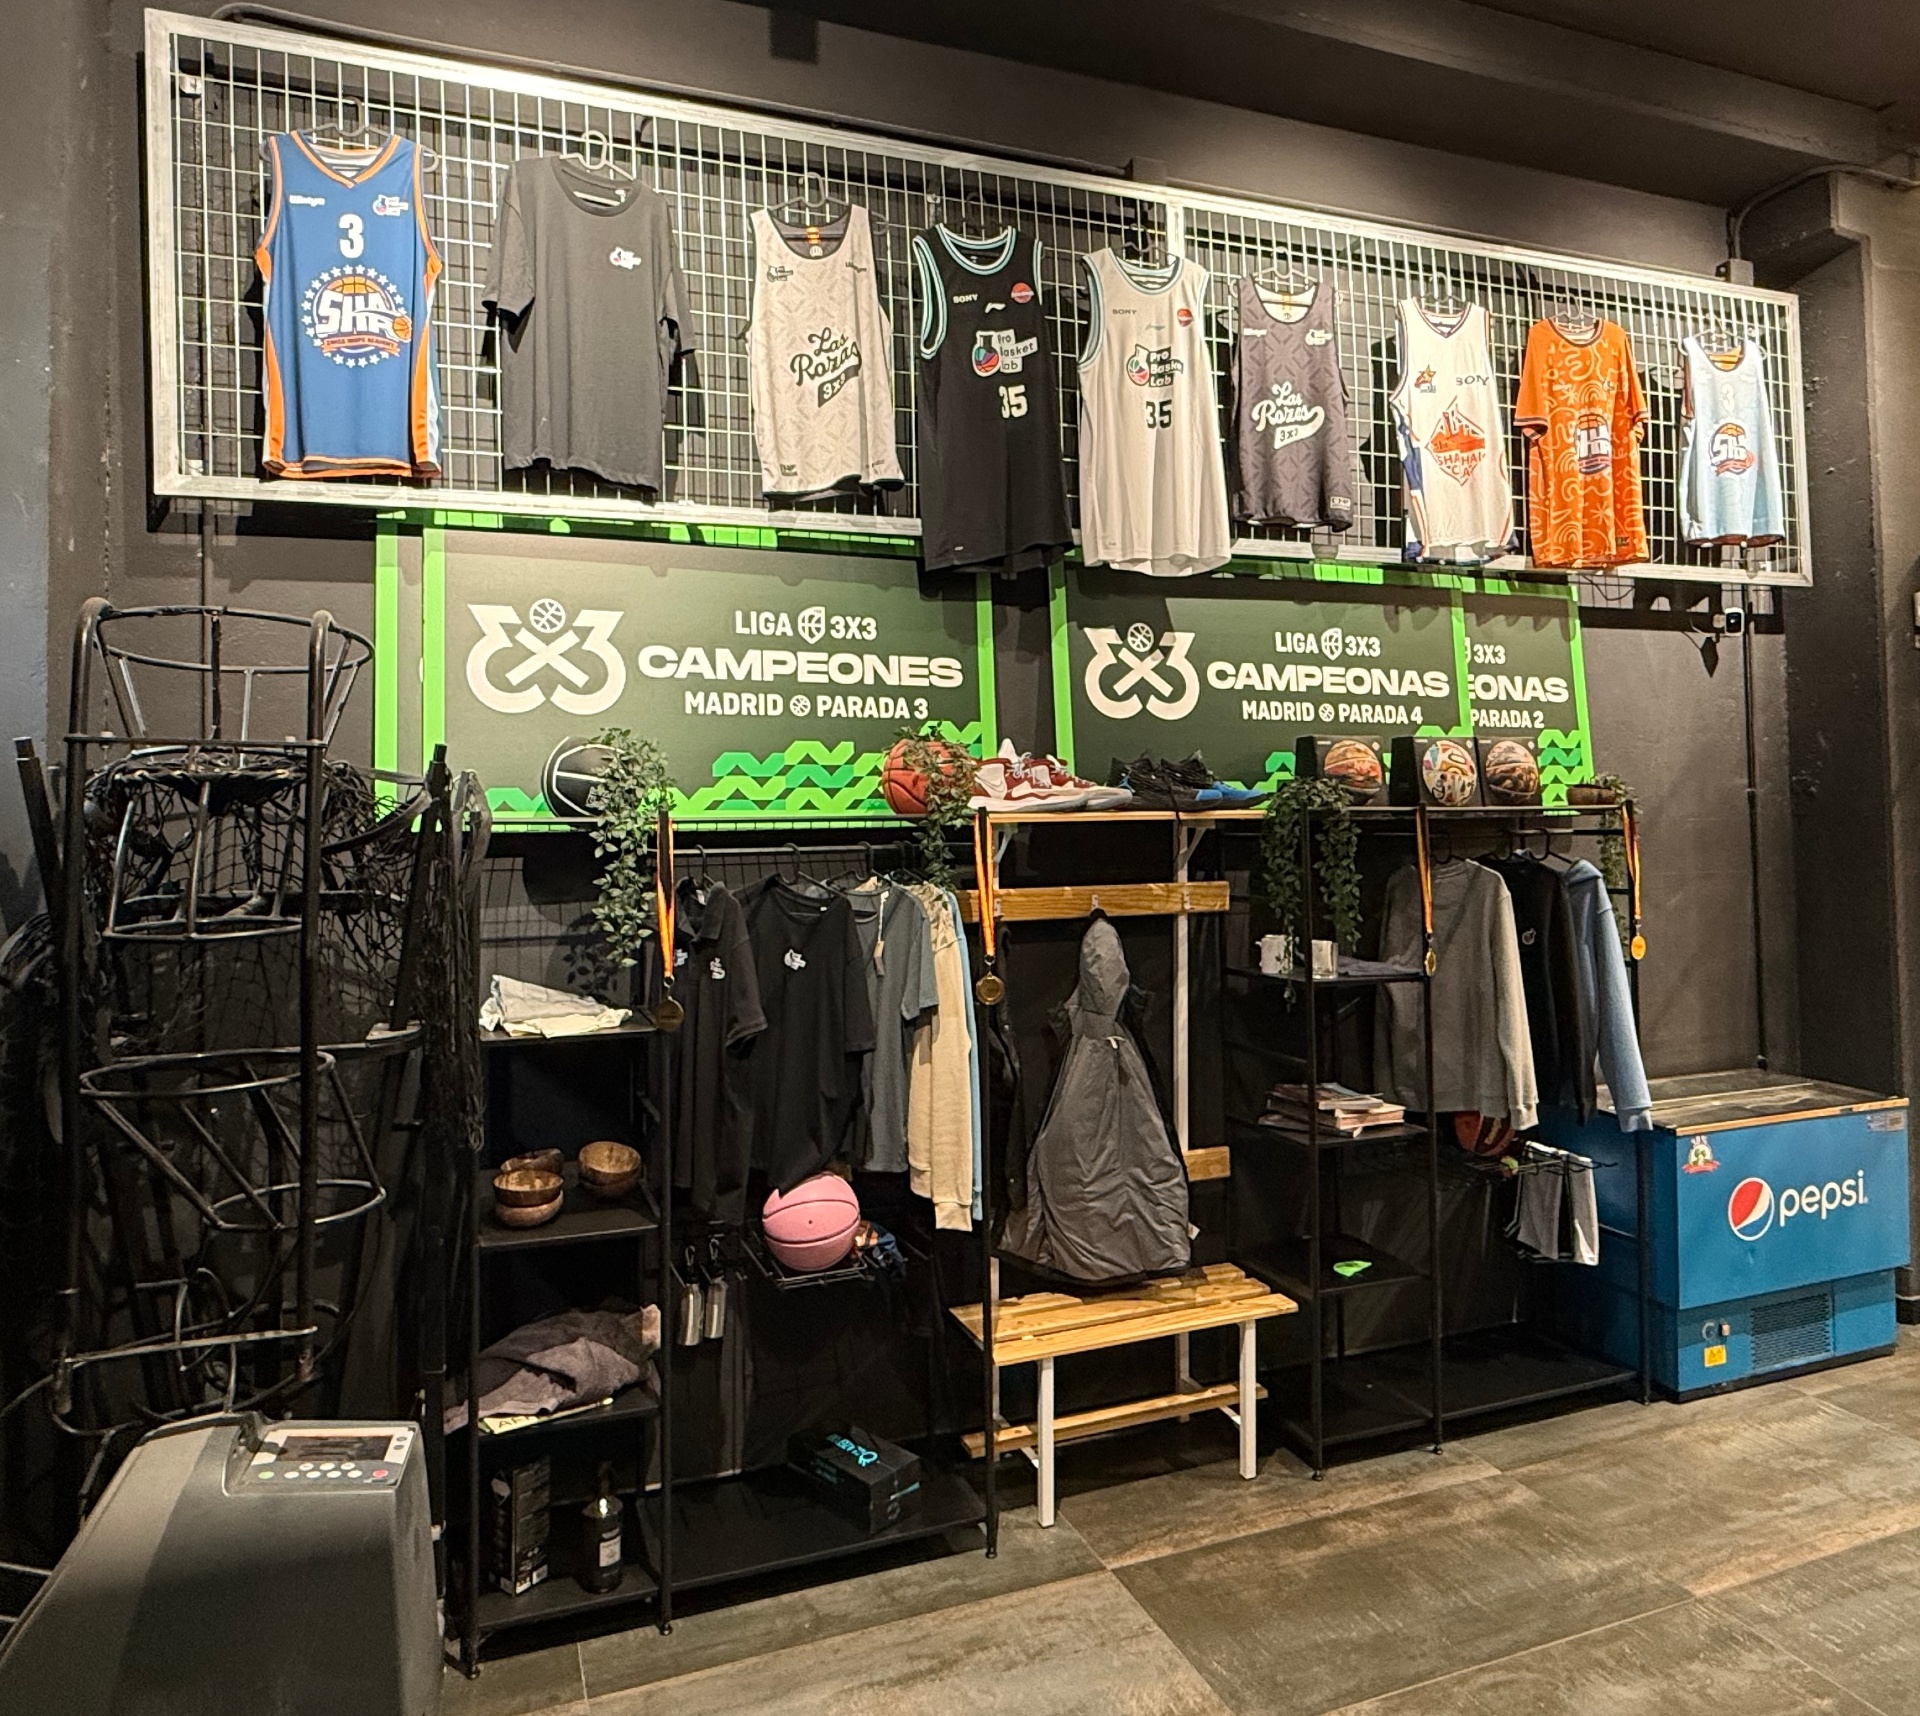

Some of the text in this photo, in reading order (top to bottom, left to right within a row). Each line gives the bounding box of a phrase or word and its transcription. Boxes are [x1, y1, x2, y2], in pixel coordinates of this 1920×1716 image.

[339, 214, 364, 258] 3
[953, 293, 978, 304] SONY
[807, 326, 849, 357] Las
[1150, 350, 1170, 362] Pro
[1150, 375, 1172, 387] Lab
[1145, 399, 1172, 429] 35
[735, 610, 878, 640] LIGA 3X3
[1275, 631, 1381, 658] LIGA 3X3
[1473, 643, 1506, 665] 3X3
[637, 644, 962, 687] CAMPEONES
[1207, 661, 1450, 698] CAMPEONAS
[685, 690, 929, 720] MADRID PARADA 3
[1243, 700, 1424, 725] MADRID PARADA 4
[1471, 708, 1545, 729] PARADA 2
[1780, 1170, 1866, 1226] pepsi
